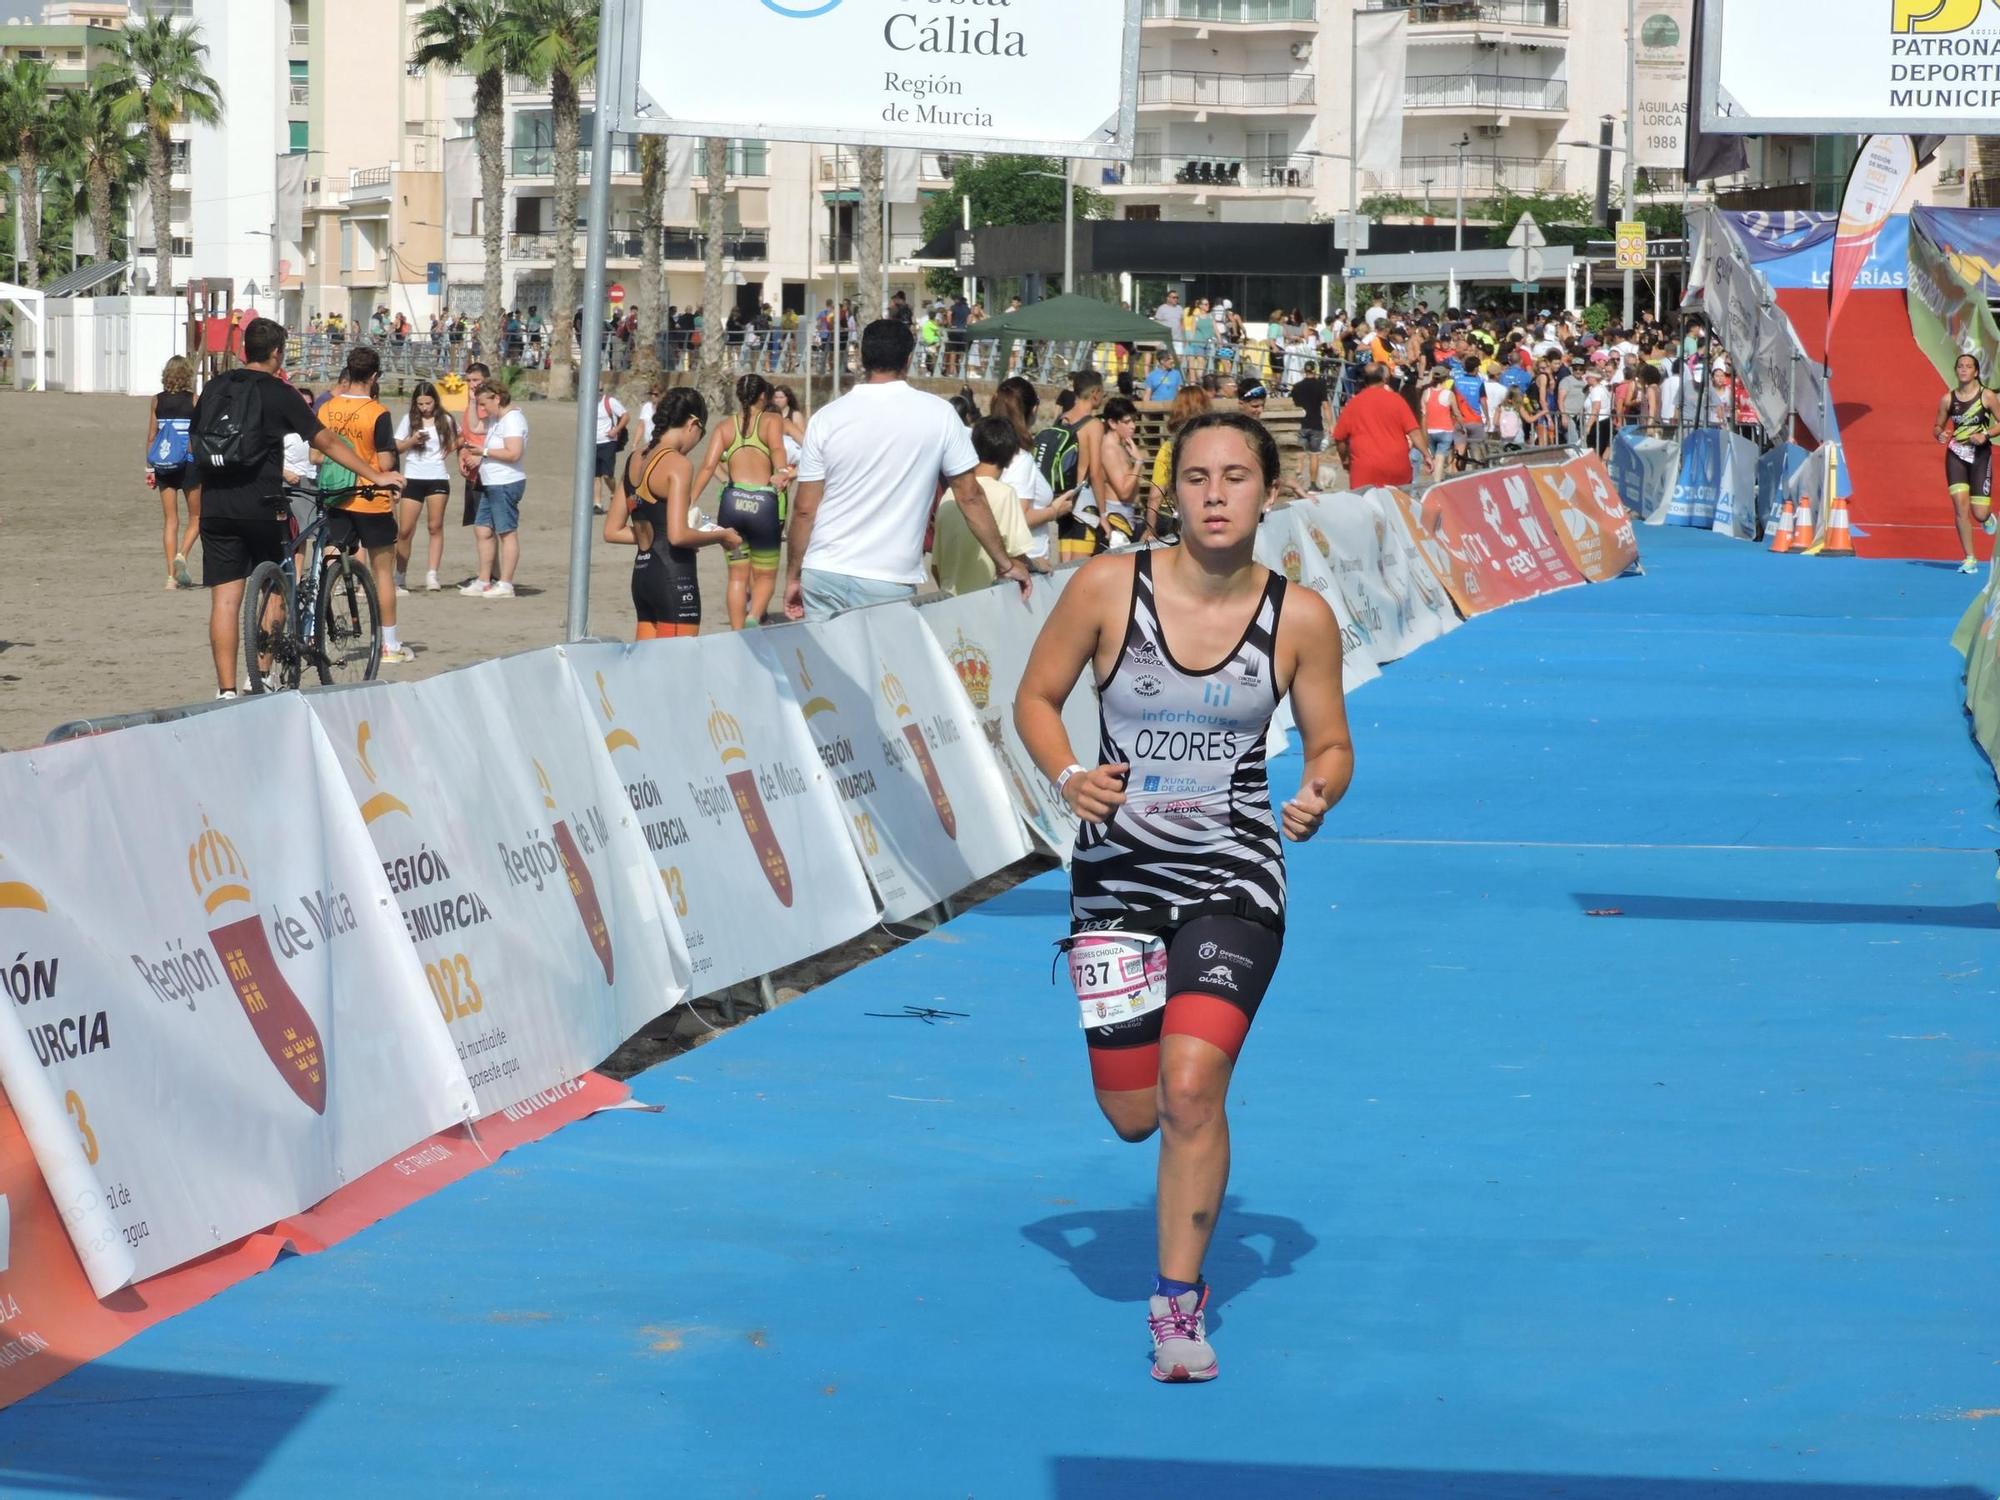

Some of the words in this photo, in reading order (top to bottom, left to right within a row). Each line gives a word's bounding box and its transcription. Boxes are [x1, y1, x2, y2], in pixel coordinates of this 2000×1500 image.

[884, 13, 1028, 58] Cálida
[884, 72, 963, 99] Región
[882, 103, 910, 124] de
[916, 105, 993, 128] Murcia
[1642, 115, 1682, 126] LORCA
[1647, 136, 1677, 149] 1988
[1141, 708, 1240, 727] inforhouse
[1135, 728, 1237, 761] OZORES
[625, 773, 663, 812] GIÓN
[835, 768, 877, 801] MURCIA
[1163, 776, 1198, 785] XUNTA
[1176, 785, 1217, 793] GALICIA
[382, 842, 450, 894] EGIÓN
[272, 904, 314, 959] de
[411, 891, 492, 942] MURCIA
[1096, 947, 1125, 957] CHOUZA
[130, 937, 221, 1012] Región
[27, 1010, 111, 1067] URCIA
[65, 1089, 100, 1166] 3
[119, 1183, 132, 1206] de
